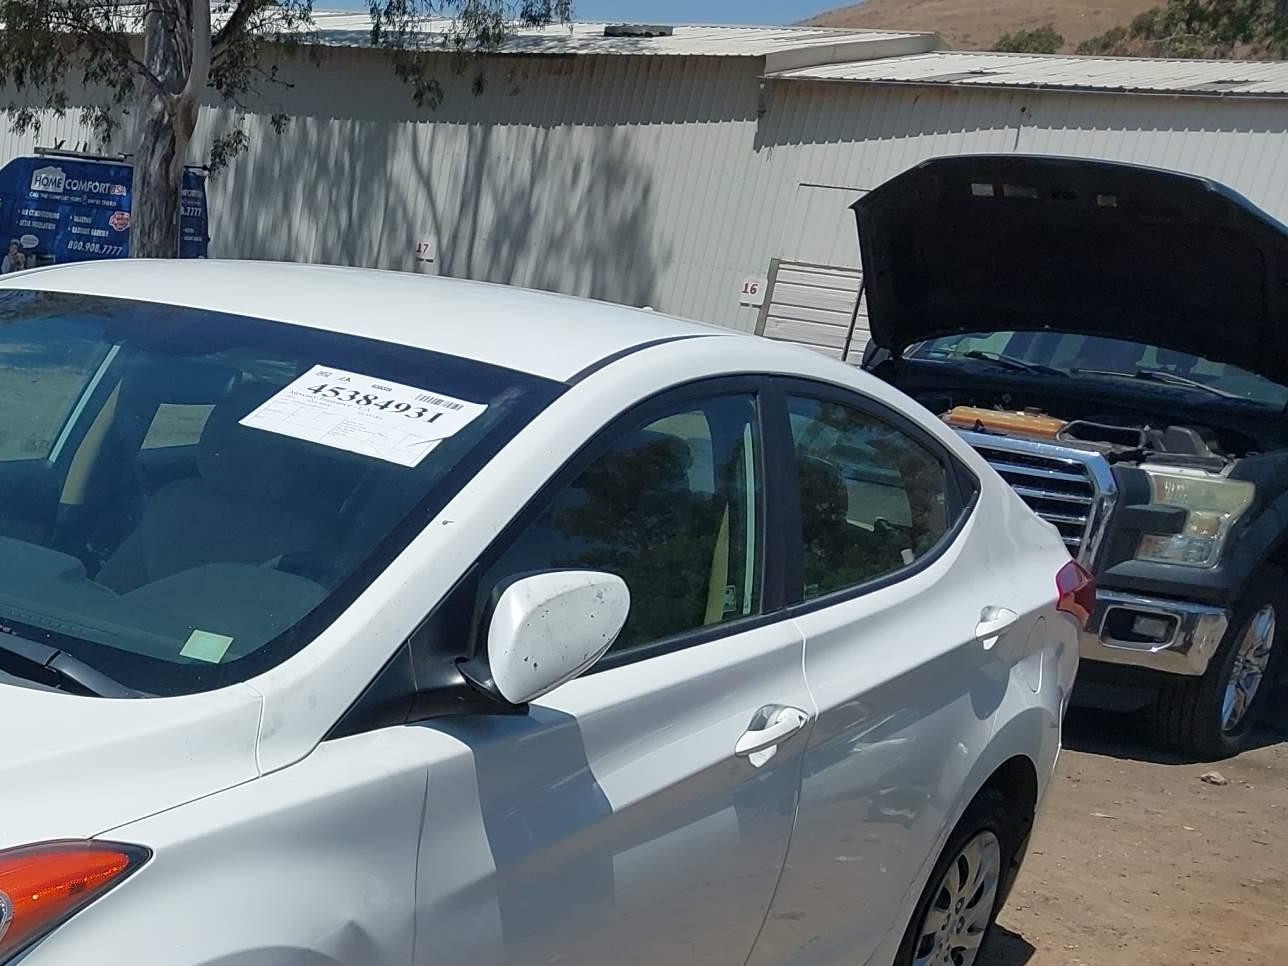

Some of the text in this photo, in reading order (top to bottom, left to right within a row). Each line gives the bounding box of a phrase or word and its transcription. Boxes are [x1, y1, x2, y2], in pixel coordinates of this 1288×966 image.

[34, 175, 63, 188] HOME
[65, 179, 110, 193] COMFORT
[67, 240, 123, 256] 800.908.7777
[416, 242, 429, 255] 17
[742, 283, 758, 294] 16
[307, 384, 444, 423] 45384931
